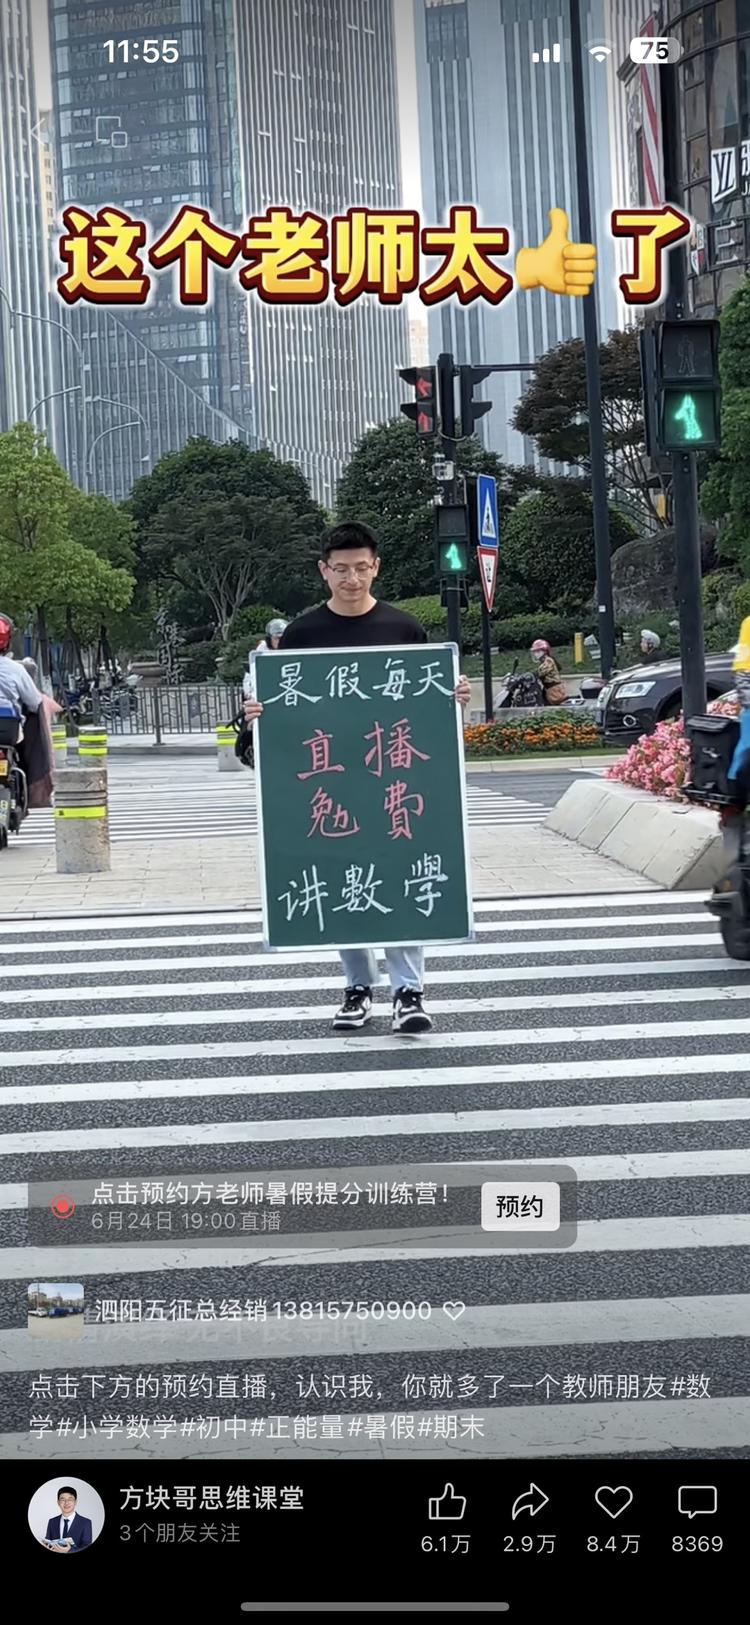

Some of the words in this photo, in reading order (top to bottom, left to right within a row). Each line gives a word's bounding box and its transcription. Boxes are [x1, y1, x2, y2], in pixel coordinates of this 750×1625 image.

[264, 658, 455, 706] 暑假每天
[297, 718, 430, 780] 直播
[278, 853, 448, 931] 讲數學
